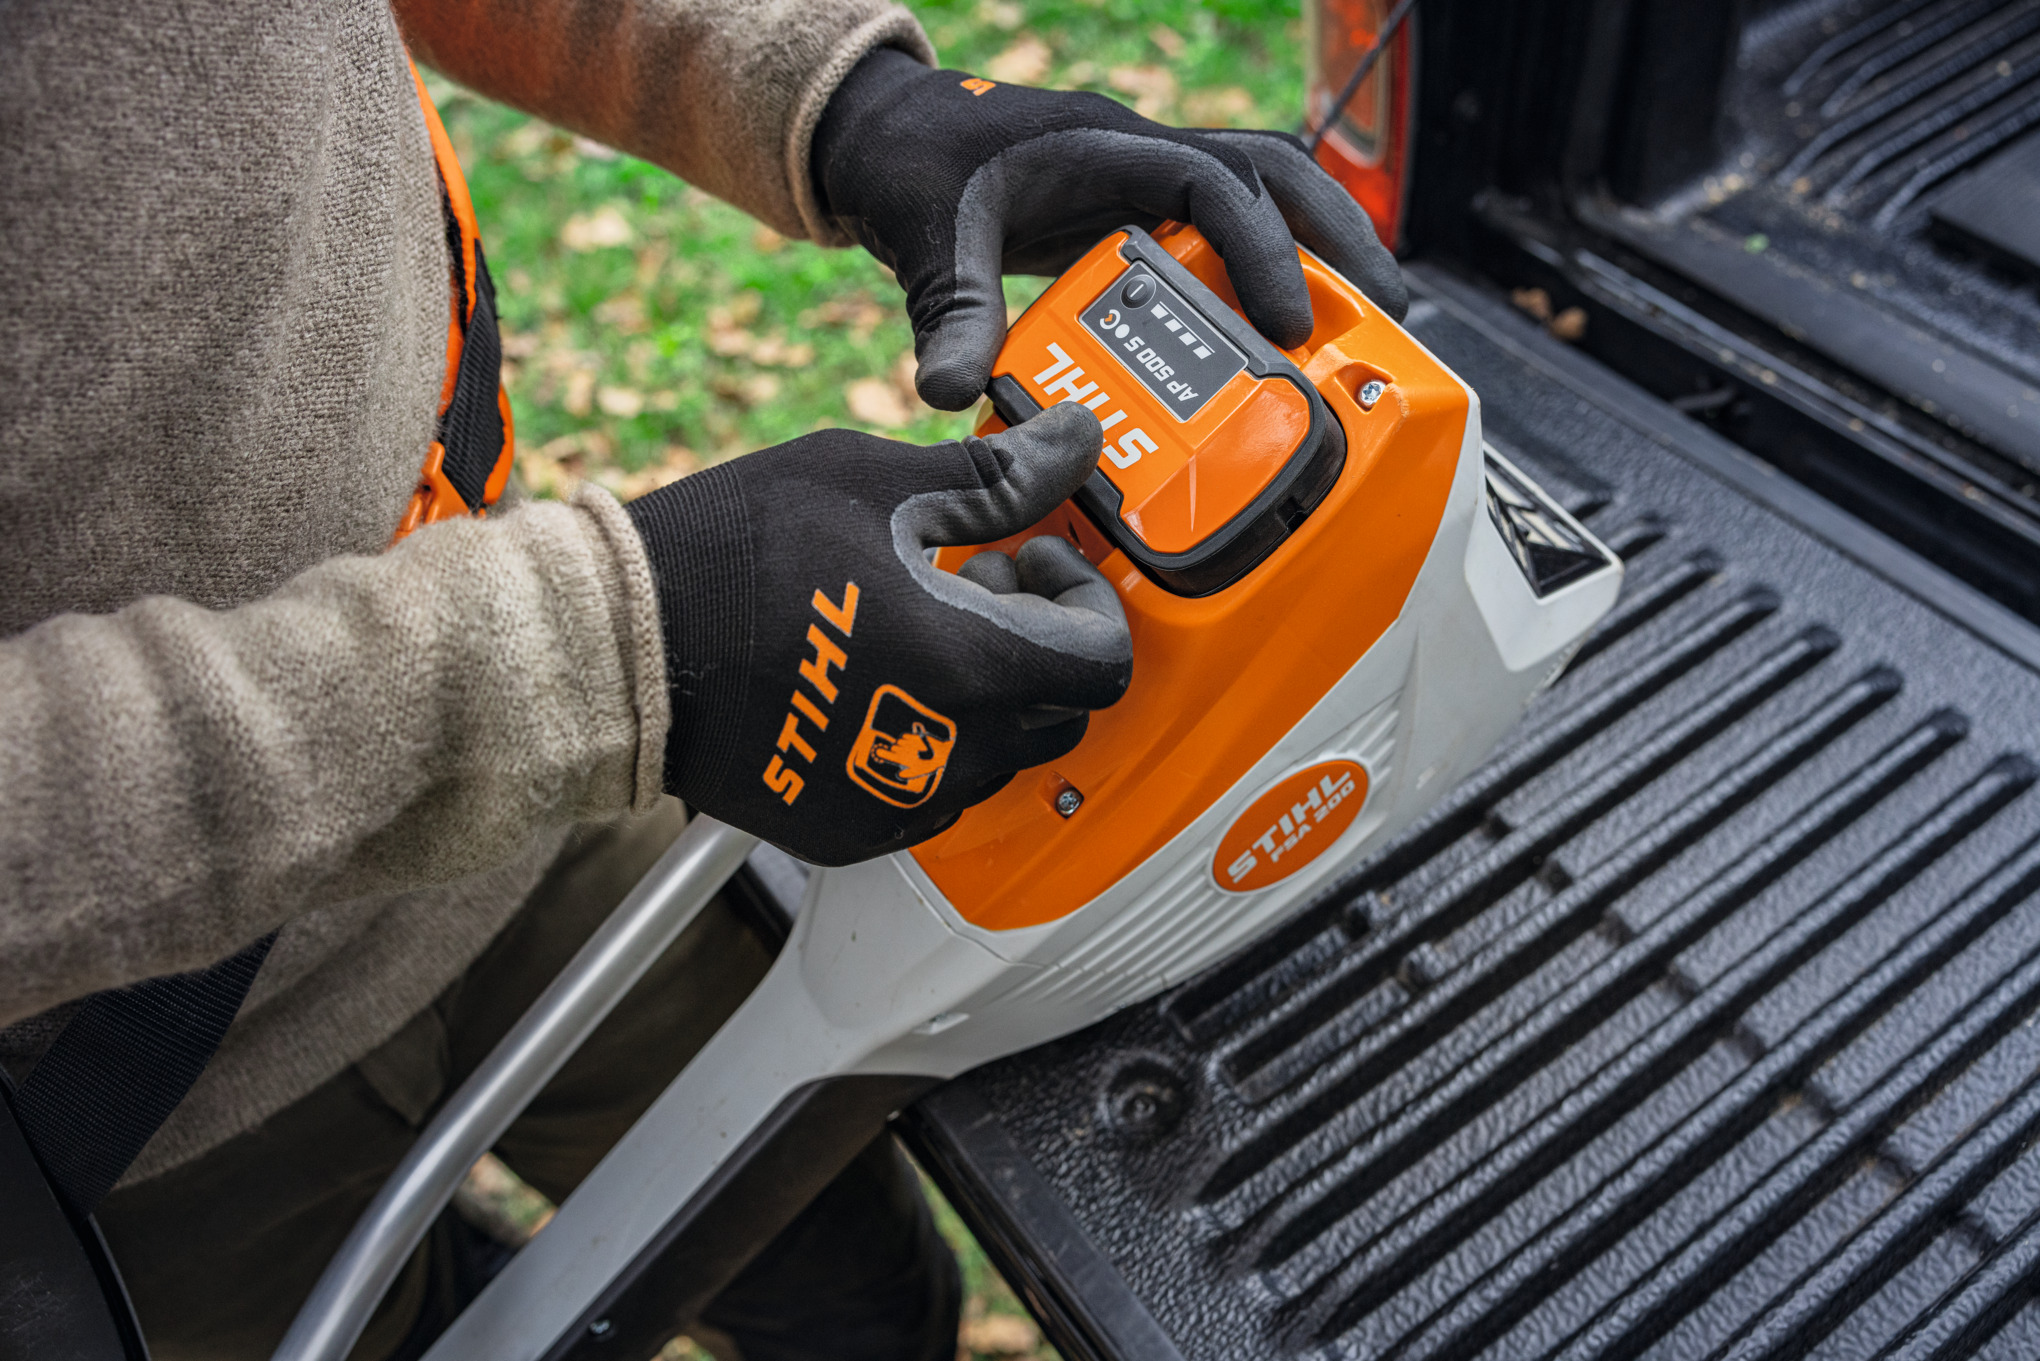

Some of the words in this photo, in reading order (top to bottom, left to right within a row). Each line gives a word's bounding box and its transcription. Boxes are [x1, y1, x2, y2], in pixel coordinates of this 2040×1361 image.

[1124, 336, 1145, 352] S
[1136, 348, 1175, 381] 500
[1167, 380, 1199, 401] AP
[763, 581, 860, 806] STIHL
[1227, 771, 1351, 883] STIHL
[1270, 824, 1312, 863] FSA
[1313, 779, 1355, 823] 200
